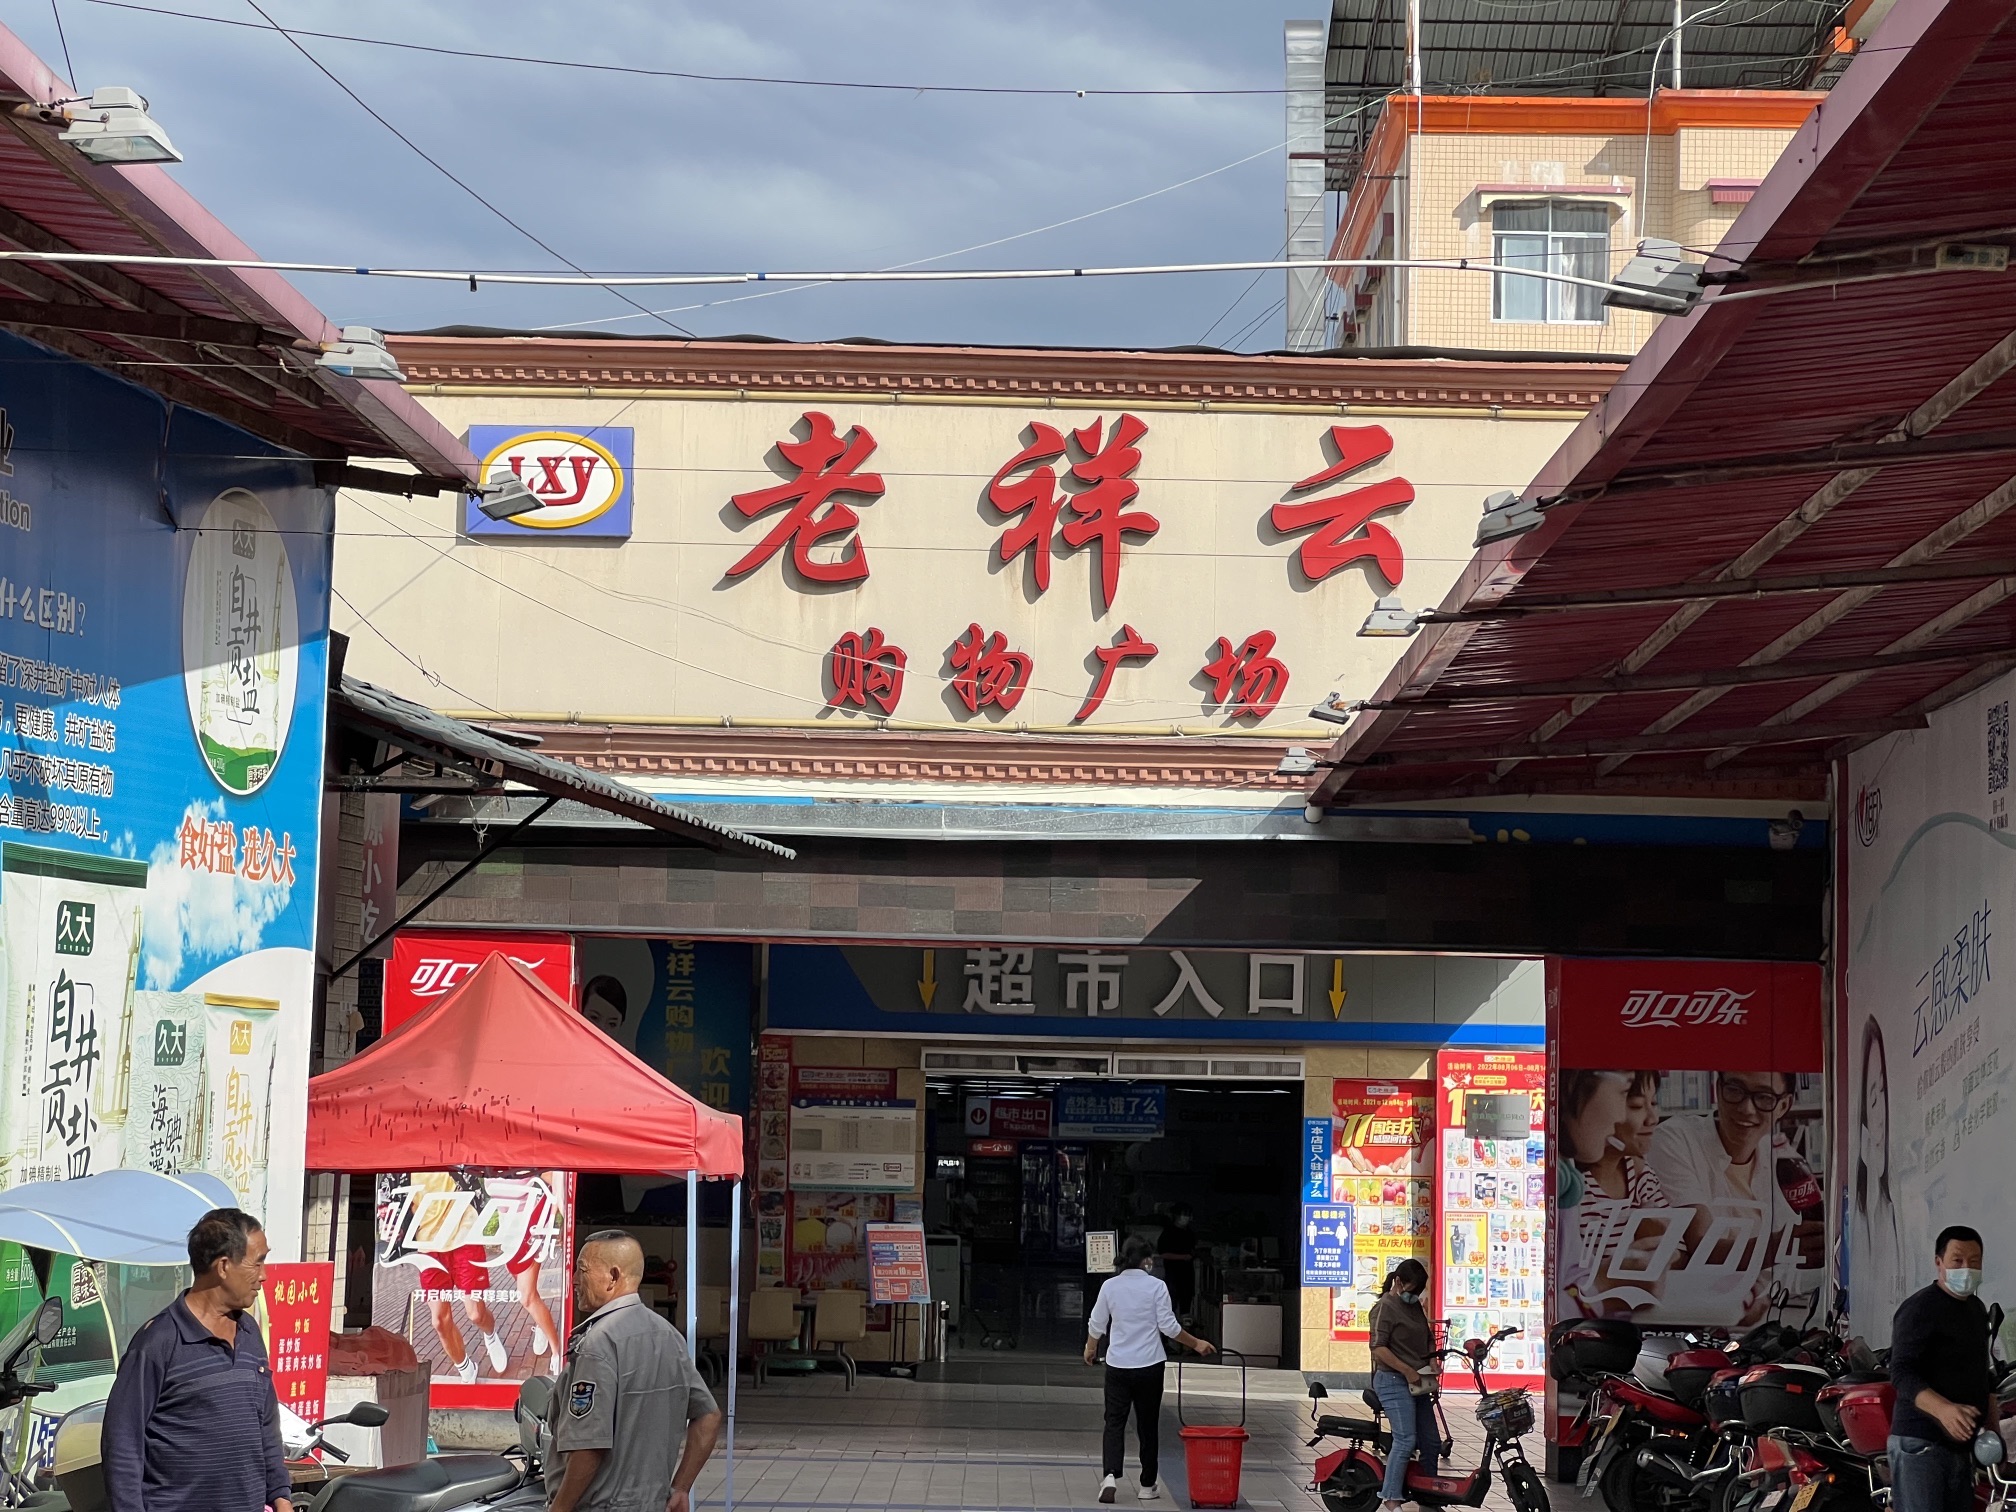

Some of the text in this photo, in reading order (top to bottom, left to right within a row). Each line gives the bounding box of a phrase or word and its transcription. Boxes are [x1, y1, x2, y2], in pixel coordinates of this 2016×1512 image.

[725, 411, 1416, 609] 老祥云
[826, 621, 1290, 724] 购物广场
[180, 814, 236, 875] 食好盐
[58, 904, 92, 945] 久大
[963, 947, 1304, 1018] 超市入口
[1620, 987, 1757, 1028] 可口可乐
[1913, 898, 1992, 1058] 云感柔肤
[157, 1023, 183, 1055] 久大
[231, 1022, 250, 1047] 久大
[1310, 1126, 1323, 1198] 本店已入驻饿了么
[413, 1289, 522, 1303] 开启畅爽 尽释美妙
